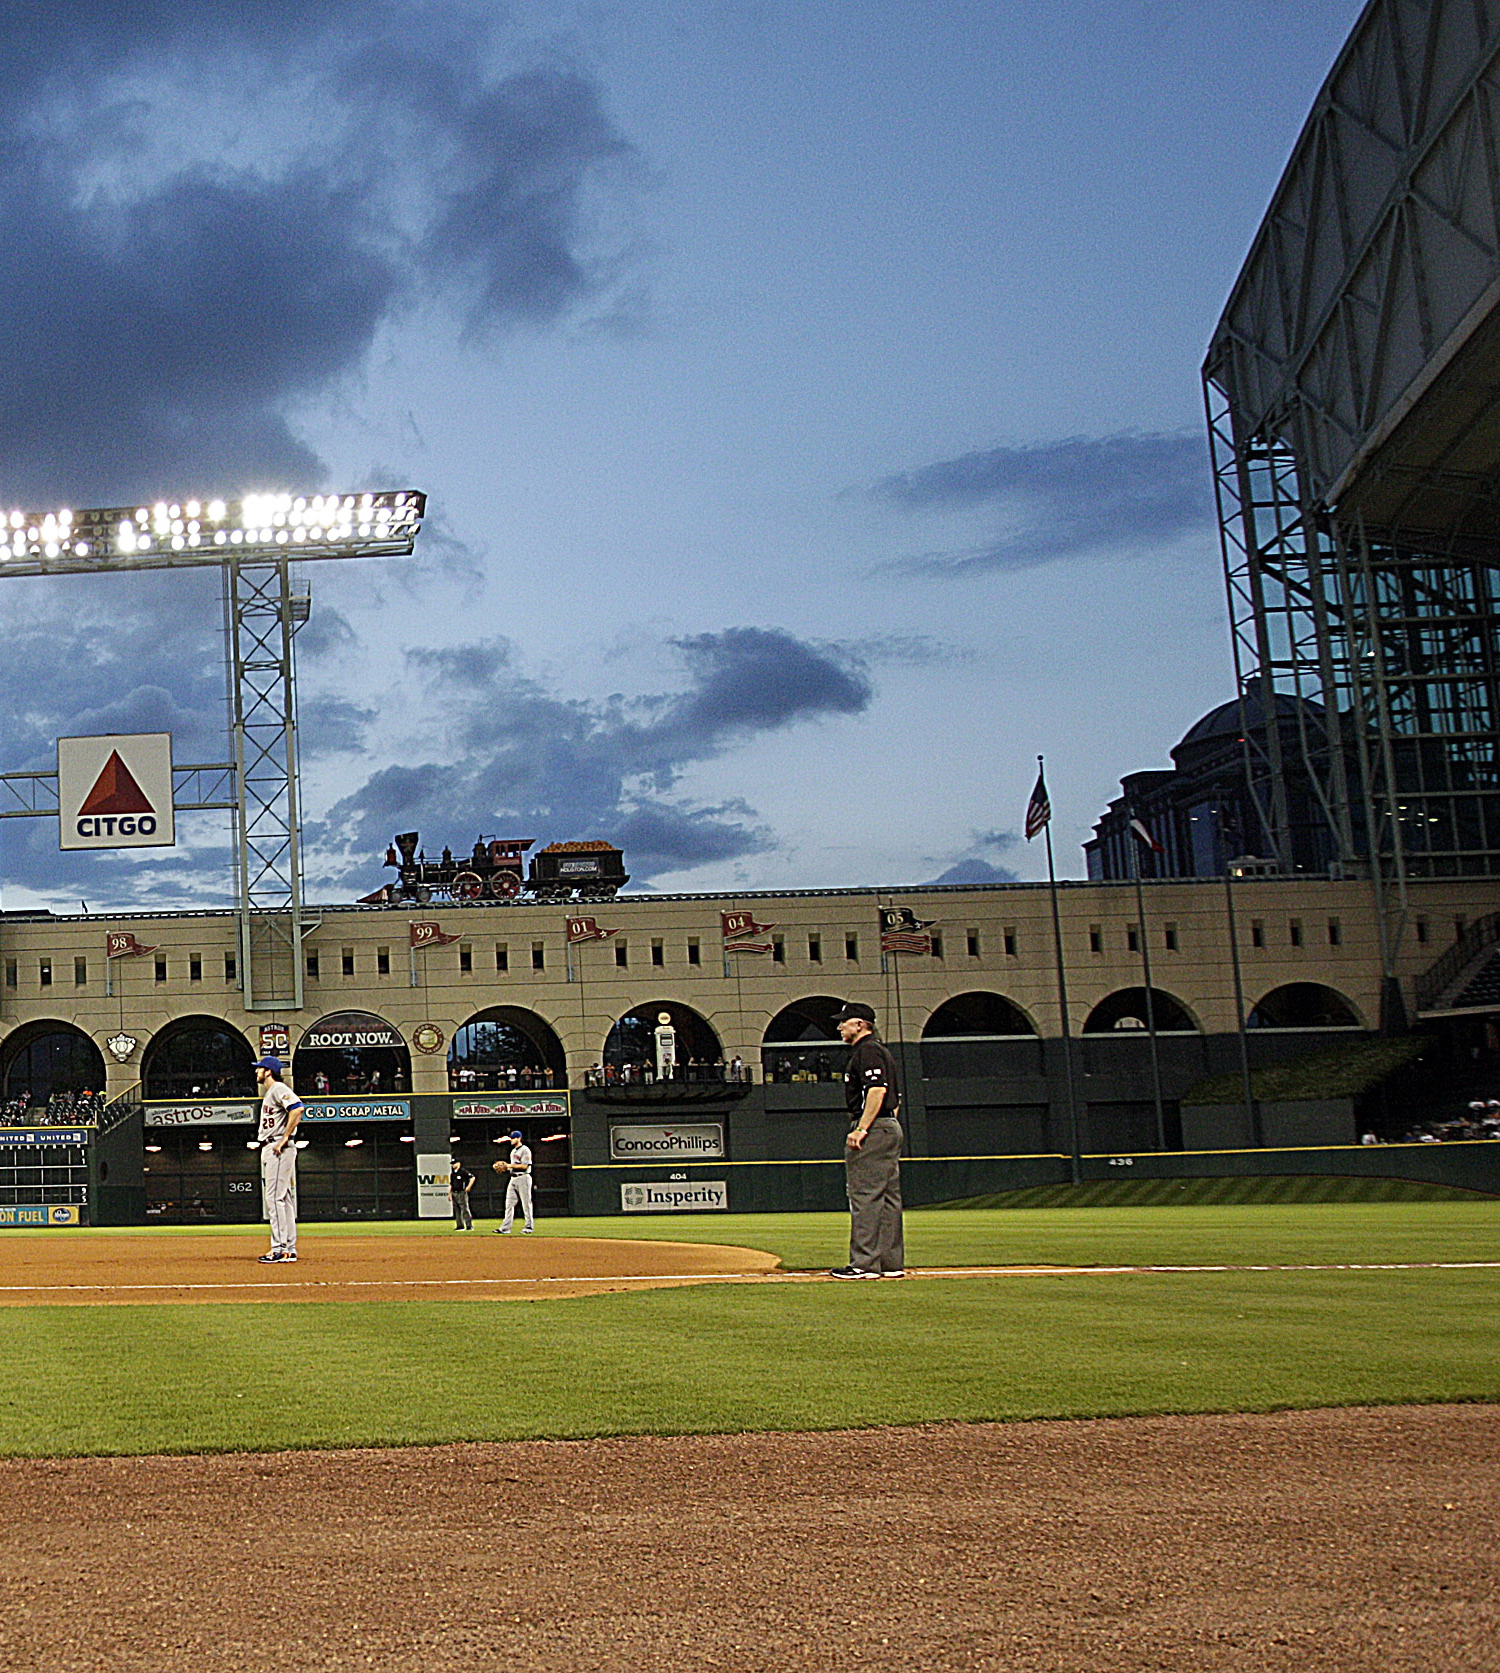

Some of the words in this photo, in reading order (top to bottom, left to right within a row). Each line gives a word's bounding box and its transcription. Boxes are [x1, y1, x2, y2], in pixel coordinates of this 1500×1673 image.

[77, 816, 156, 837] CITGO
[728, 917, 745, 930] 04
[887, 913, 904, 924] 05
[417, 927, 433, 939] 99
[572, 921, 588, 934] 01
[112, 937, 127, 950] 98
[261, 1033, 288, 1049] 50
[310, 1033, 352, 1046] ROOT
[355, 1032, 393, 1045] NOW.
[153, 1105, 213, 1125] astros
[305, 1107, 314, 1118] C
[315, 1107, 324, 1118] &
[326, 1106, 336, 1117] D
[340, 1106, 371, 1116] SCRAP
[373, 1105, 404, 1115] METAL
[615, 1136, 720, 1151] ConocoPhillips
[1108, 1158, 1134, 1166] 436
[417, 1174, 450, 1184] WM
[229, 1182, 252, 1193] 362
[646, 1187, 723, 1206] Insperity
[18, 1212, 43, 1222] FUEL
